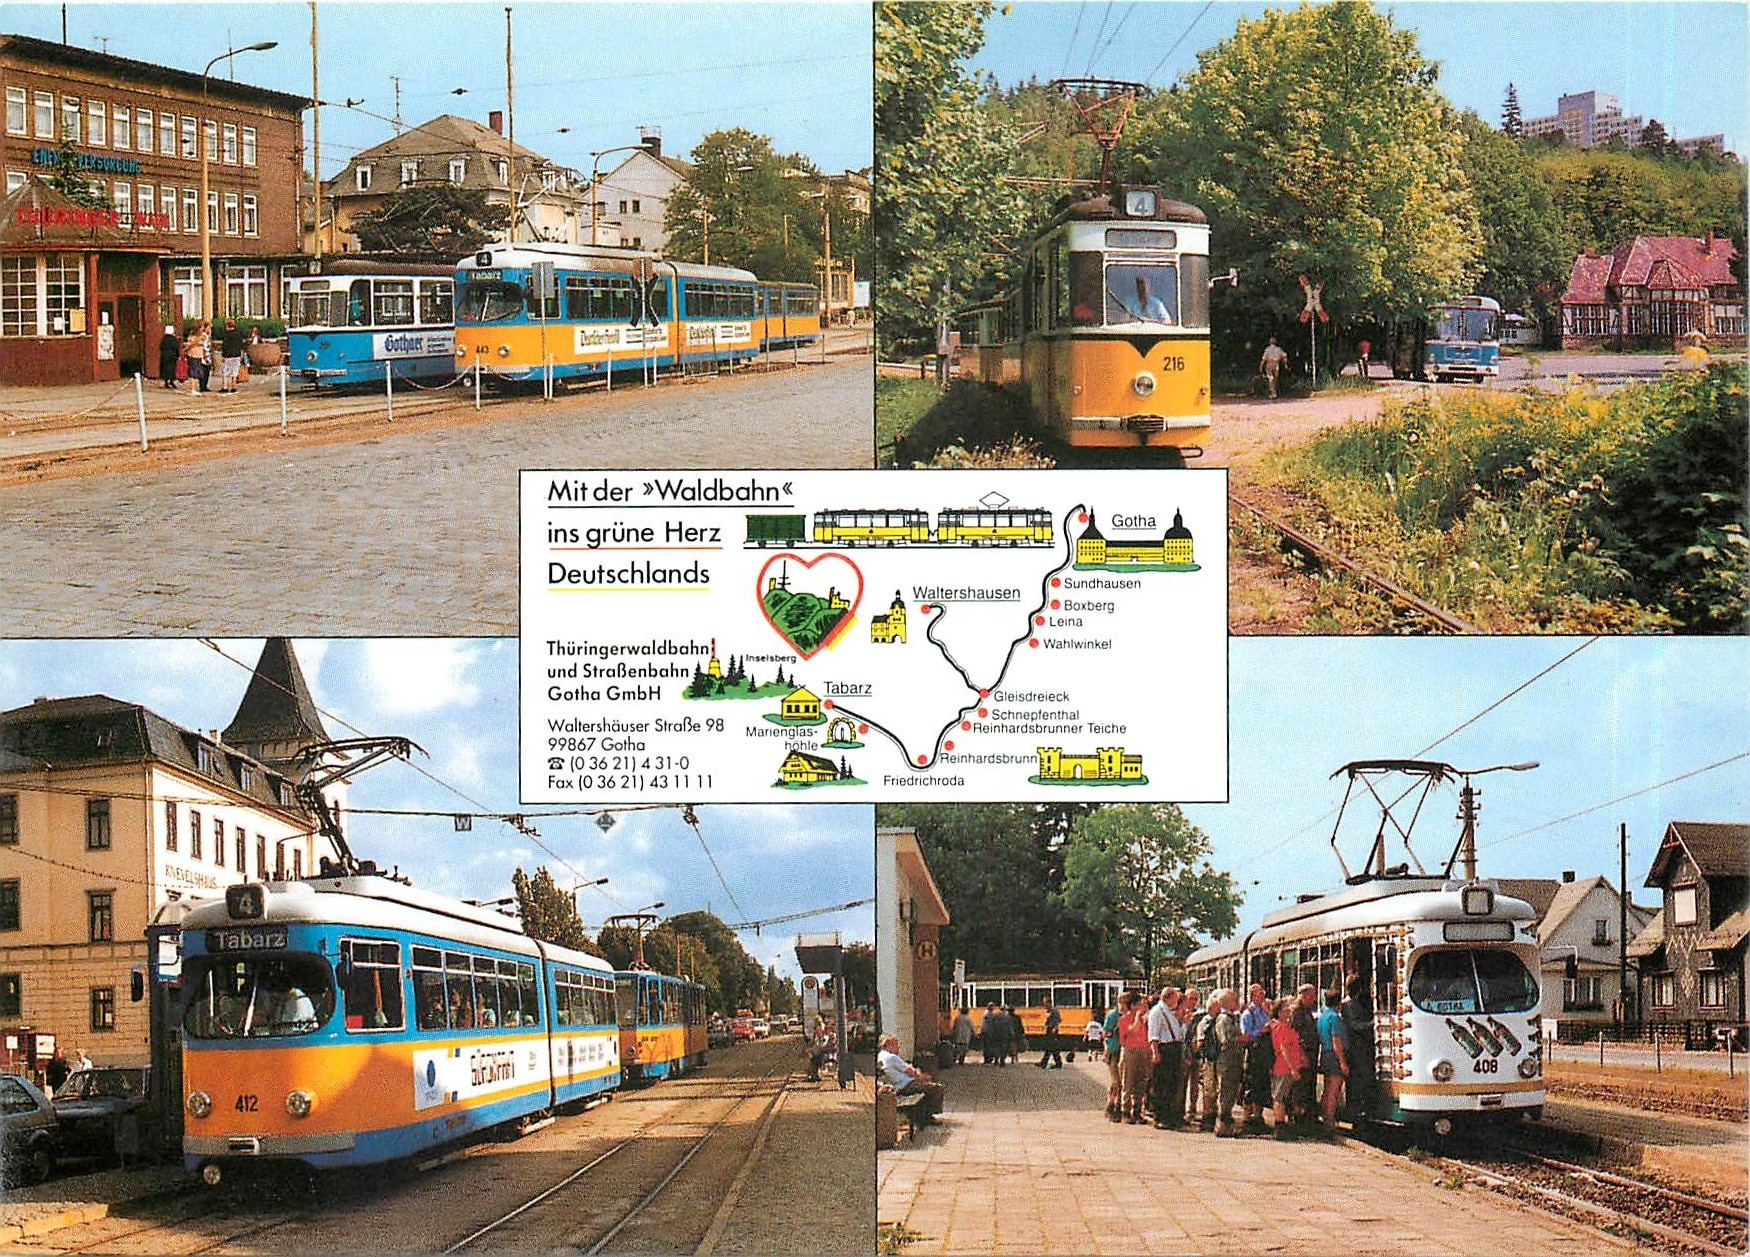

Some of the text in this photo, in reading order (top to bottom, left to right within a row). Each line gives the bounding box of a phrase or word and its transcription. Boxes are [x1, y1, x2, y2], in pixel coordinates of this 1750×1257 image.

[1135, 197, 1147, 214] 4
[481, 253, 488, 265] 4
[1163, 356, 1185, 371] 216
[217, 931, 285, 949] Tabarz
[1473, 1060, 1498, 1073] 408
[235, 1094, 258, 1112] 412
